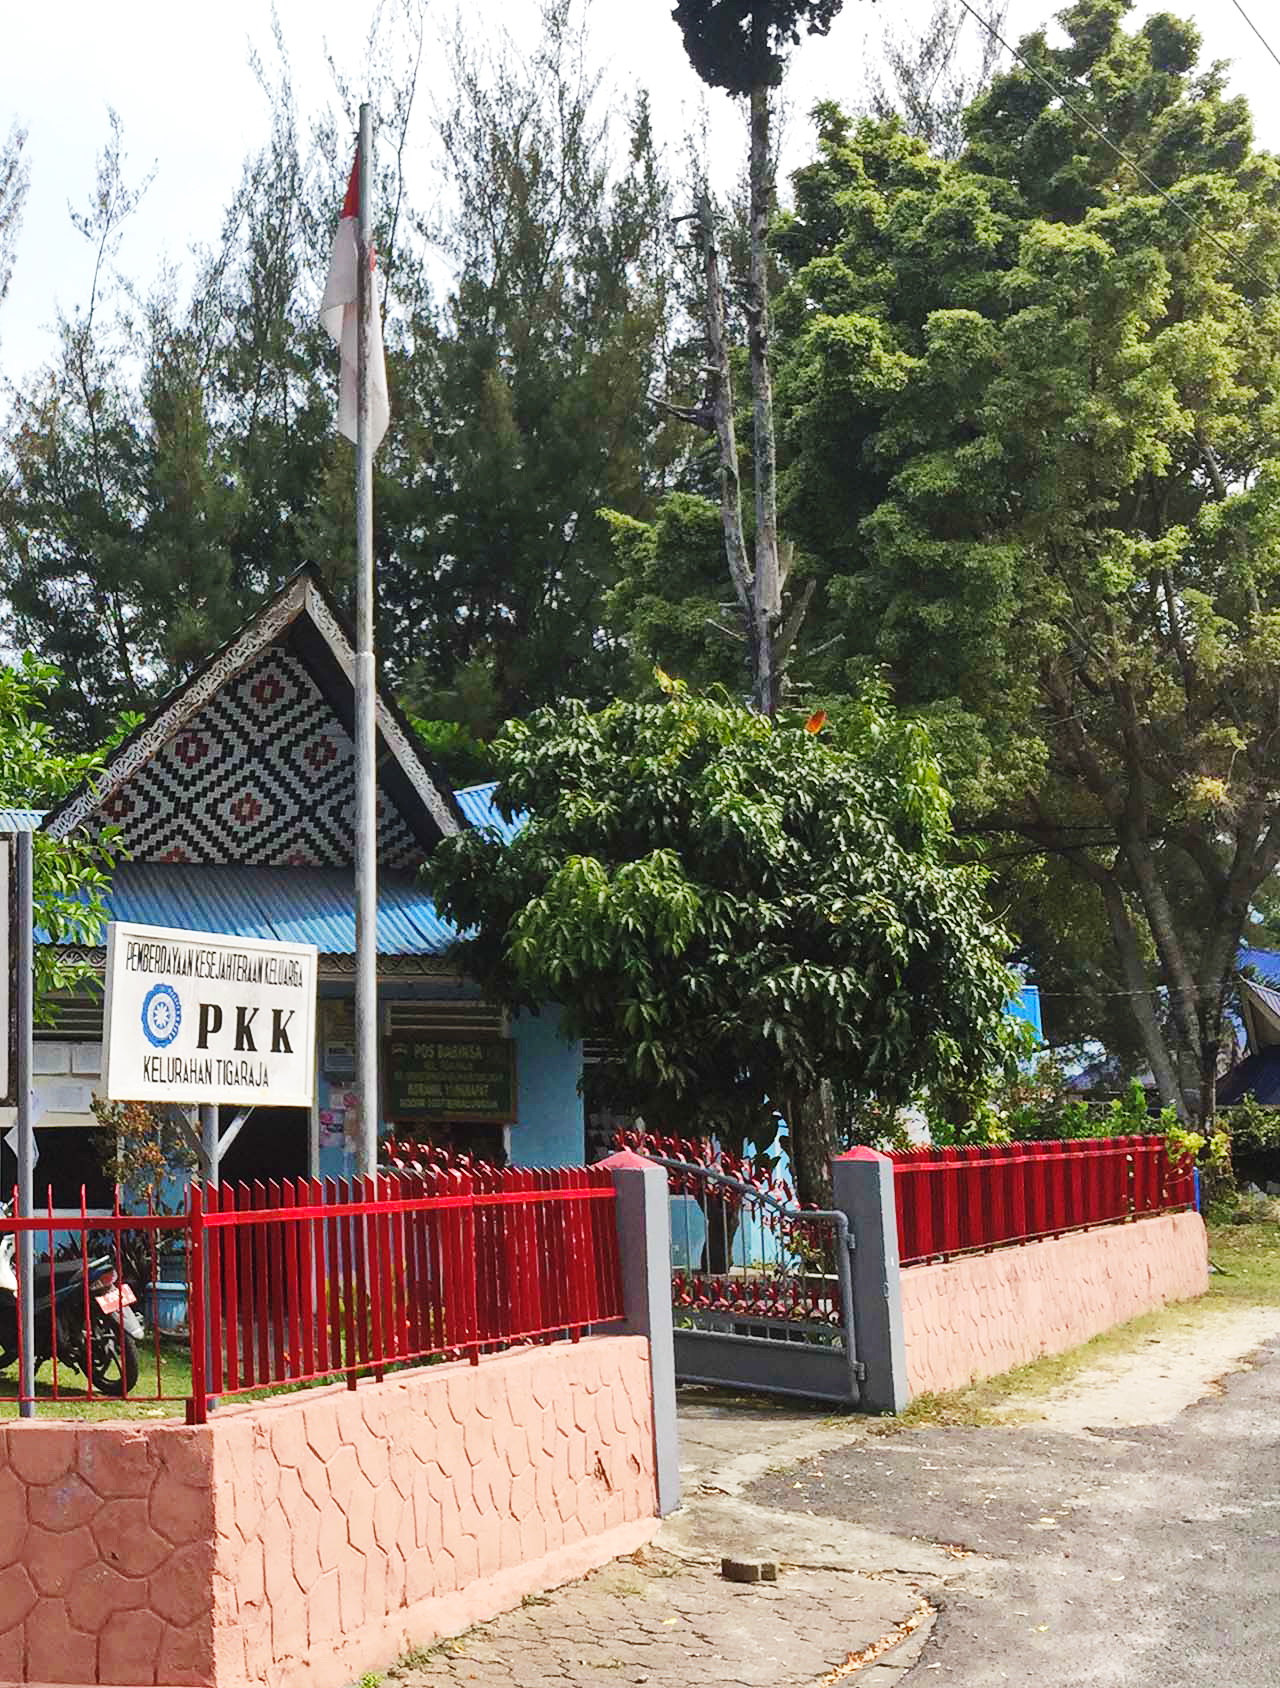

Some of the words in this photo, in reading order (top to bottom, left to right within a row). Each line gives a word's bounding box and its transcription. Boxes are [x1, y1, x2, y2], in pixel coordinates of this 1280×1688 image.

[126, 941, 193, 977] PEMBERDAYAAN
[194, 949, 263, 984] KESEJAHTERAAN
[264, 957, 303, 988] KELUARGA
[143, 1055, 213, 1086] KELURAHAN
[216, 1059, 270, 1088] TIGARAJA
